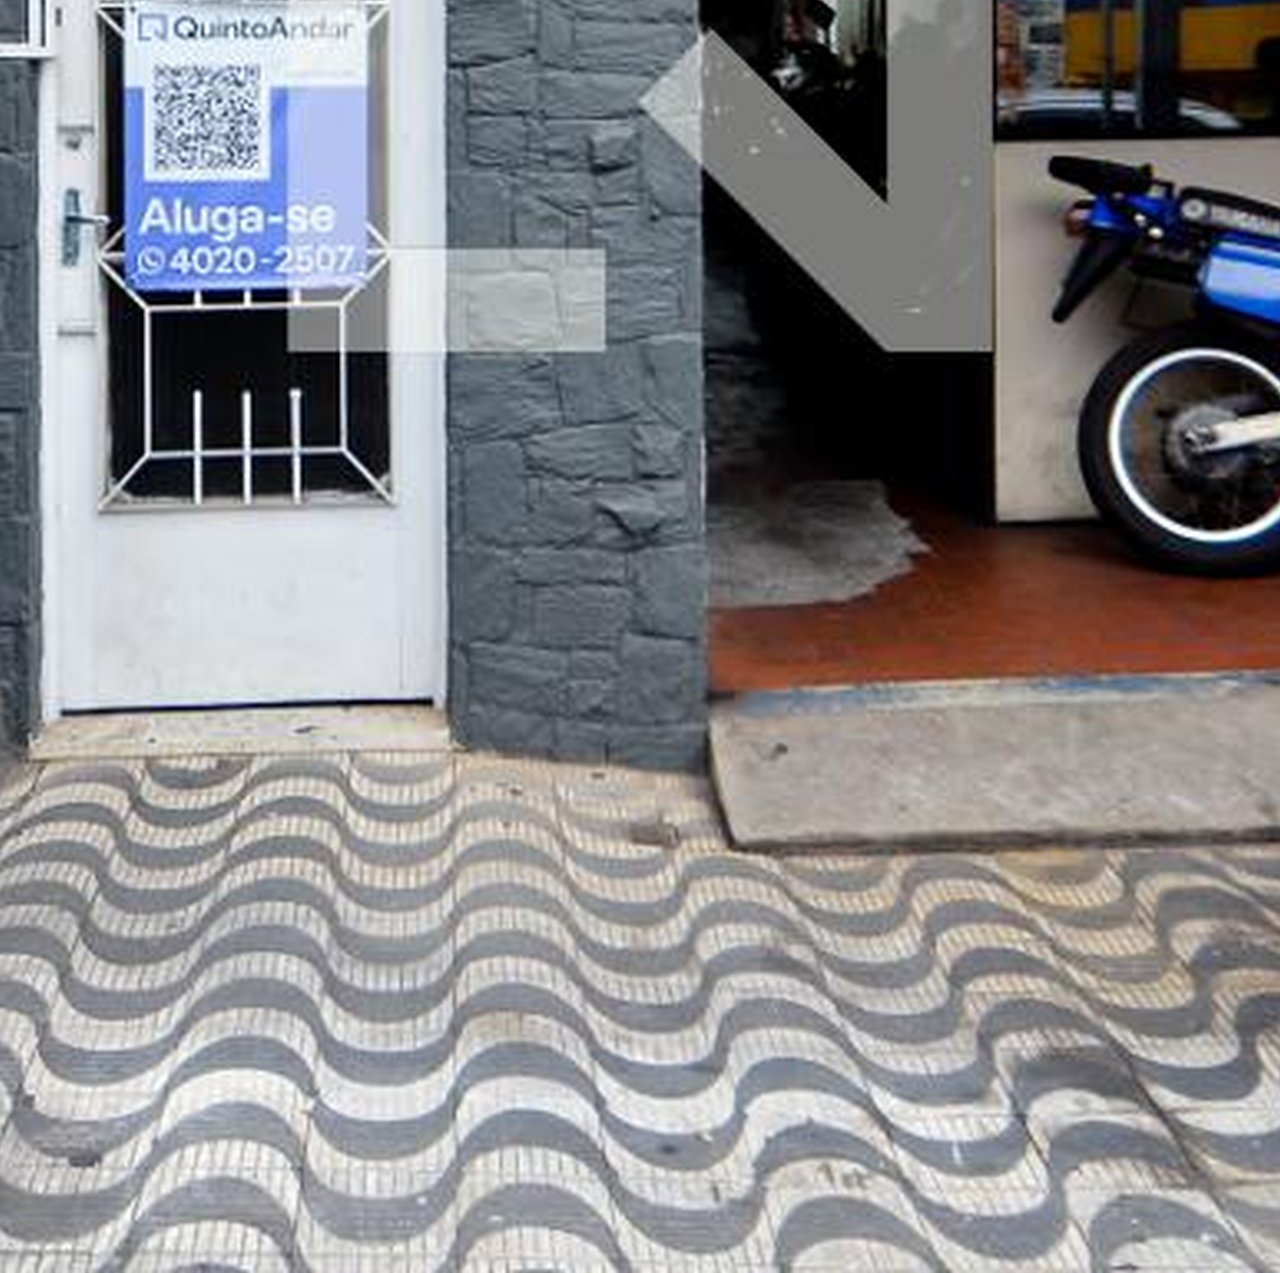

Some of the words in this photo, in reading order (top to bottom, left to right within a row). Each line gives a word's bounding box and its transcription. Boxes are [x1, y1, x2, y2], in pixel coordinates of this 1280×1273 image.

[173, 15, 355, 41] QuintoAndar
[138, 197, 337, 242] Aluga-se
[169, 245, 356, 275] 4020-2507
